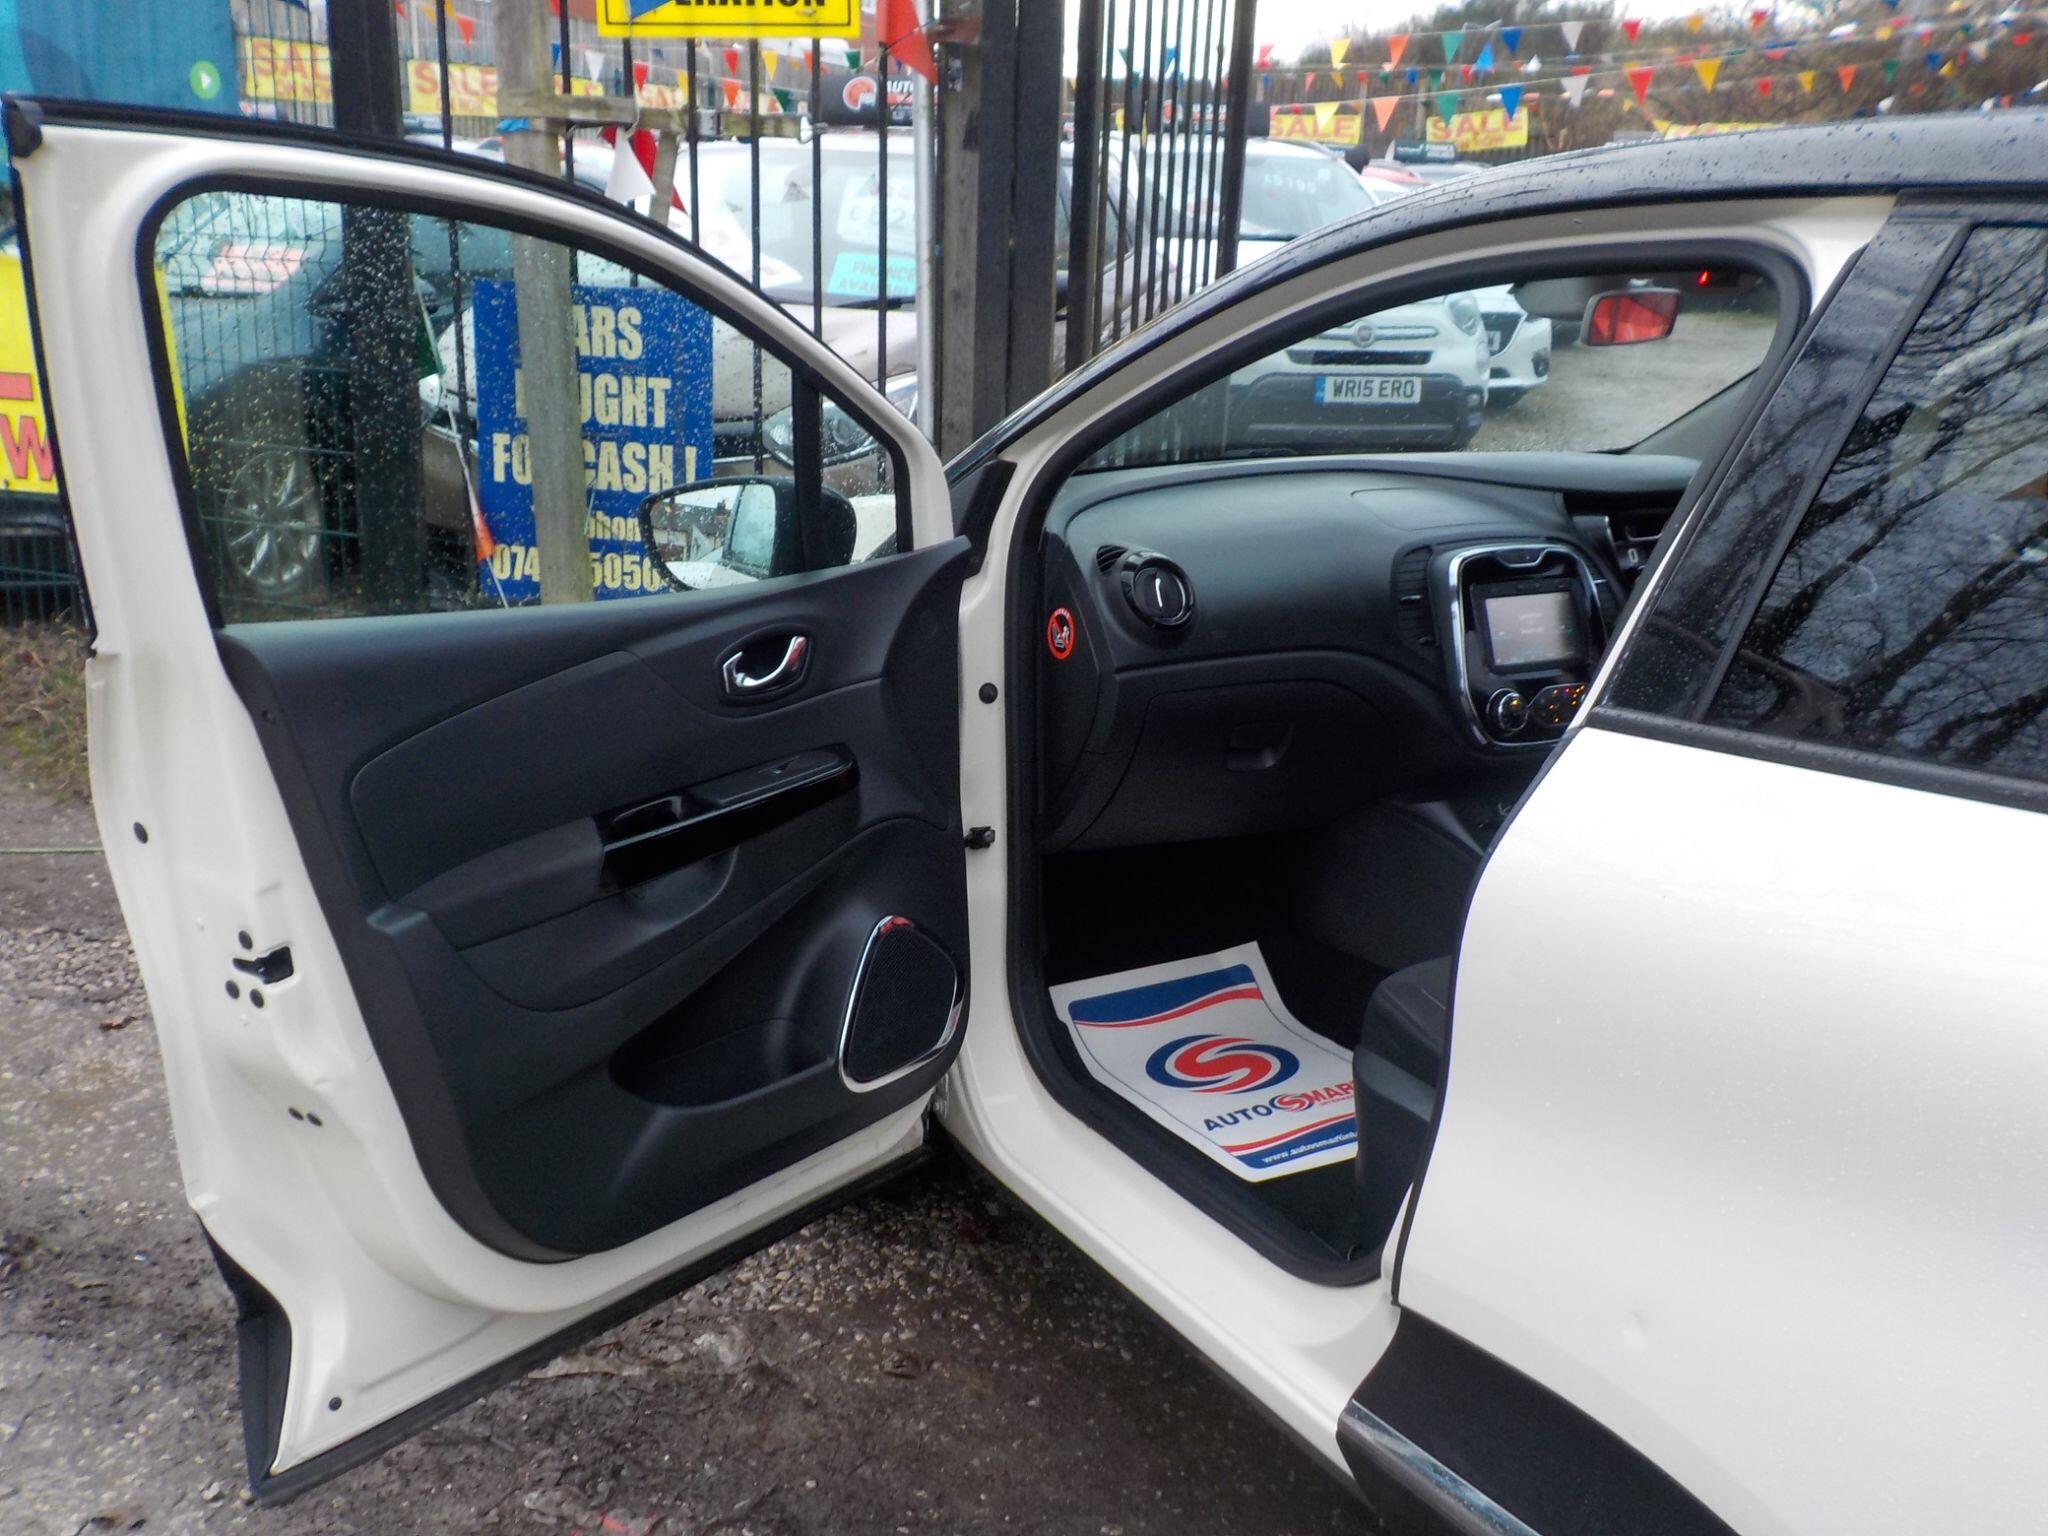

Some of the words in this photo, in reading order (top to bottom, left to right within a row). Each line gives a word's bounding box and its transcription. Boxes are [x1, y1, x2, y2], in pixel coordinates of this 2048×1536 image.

[1269, 114, 1356, 138] SALE
[1431, 106, 1523, 140] SALE
[573, 304, 643, 360] ARS
[1333, 380, 1373, 398] WR15
[1378, 380, 1415, 399] ERO
[582, 441, 674, 494] CASH
